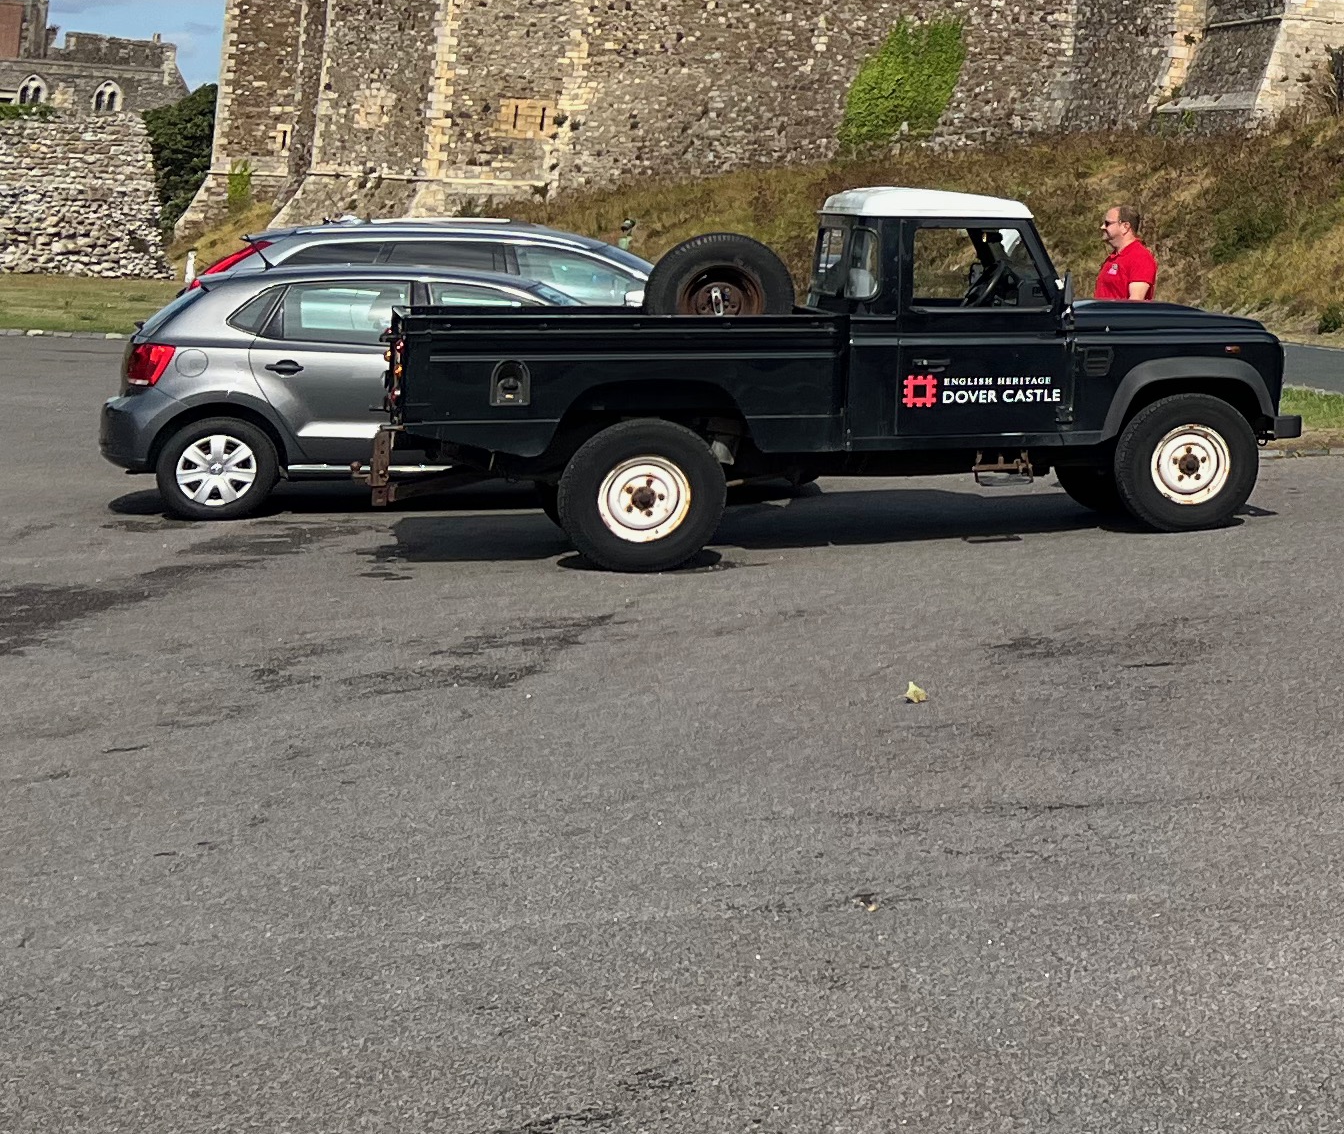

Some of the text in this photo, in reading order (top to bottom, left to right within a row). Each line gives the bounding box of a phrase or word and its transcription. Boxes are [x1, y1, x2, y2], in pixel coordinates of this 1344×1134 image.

[943, 376, 1052, 386] ENGLISH HERITAGE
[942, 388, 1061, 404] DOVER CASTLE
